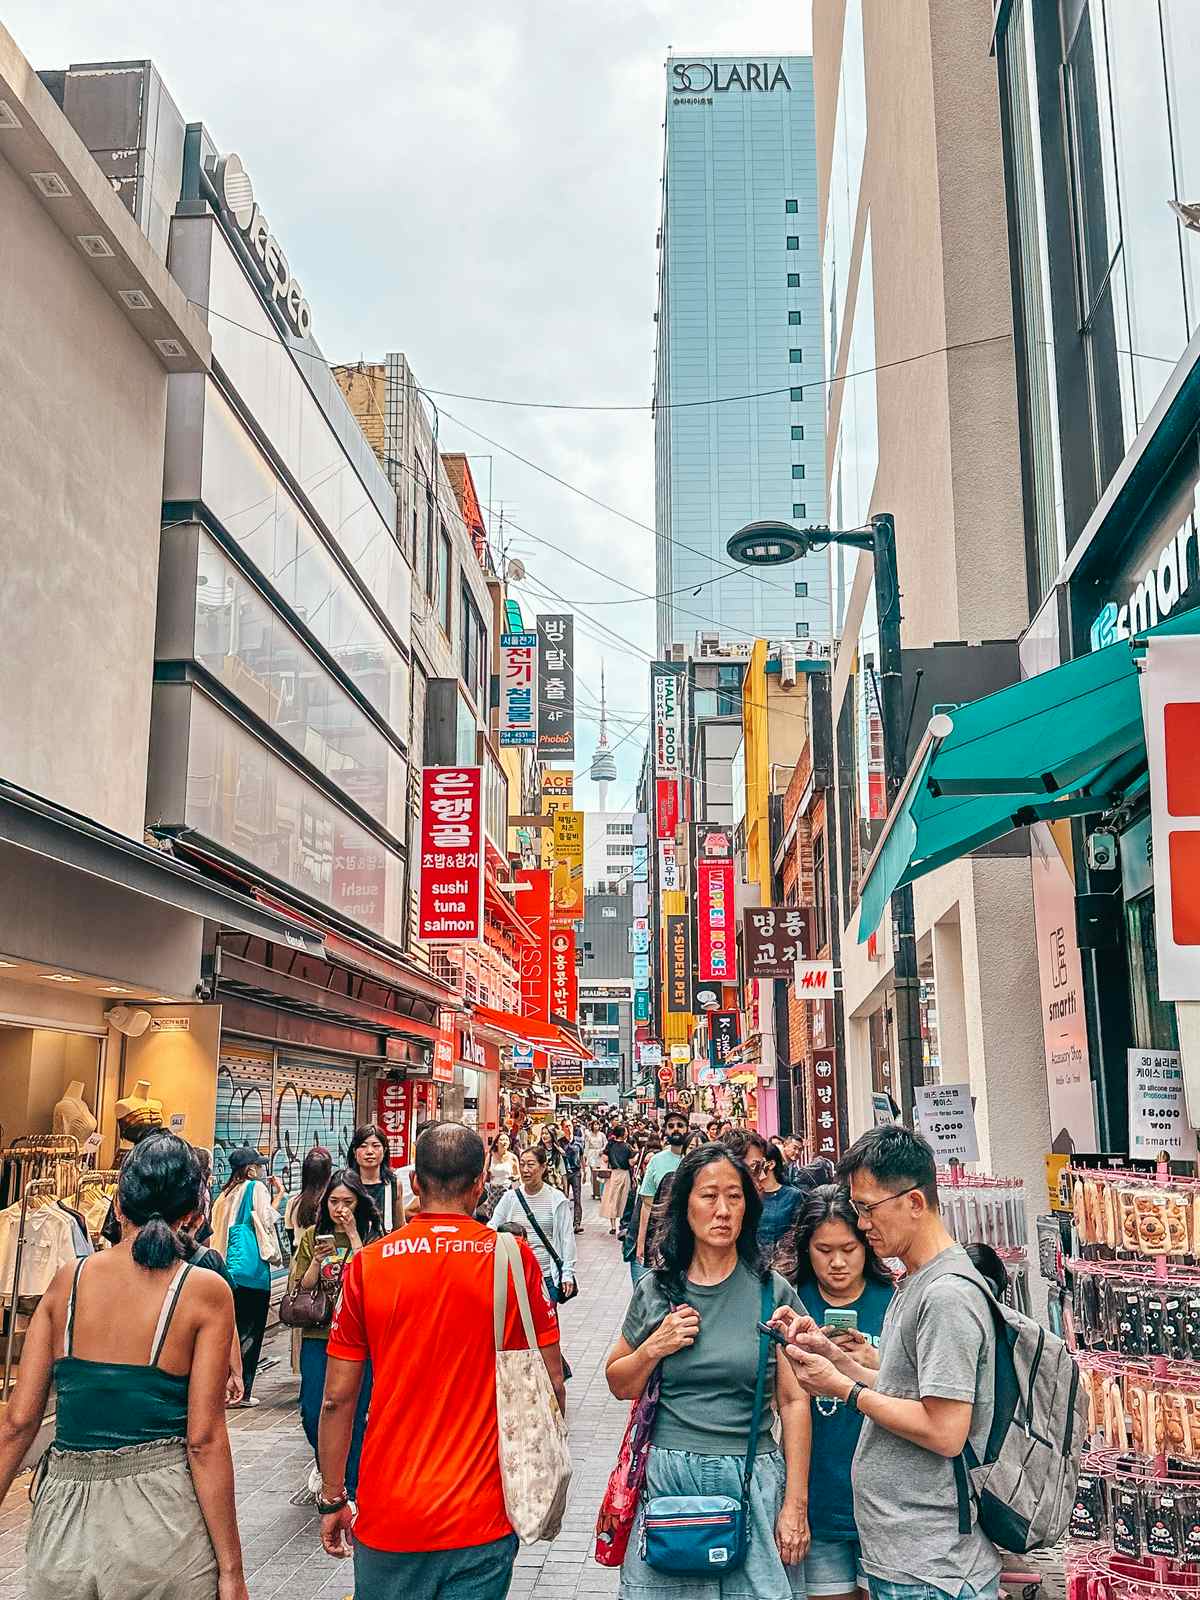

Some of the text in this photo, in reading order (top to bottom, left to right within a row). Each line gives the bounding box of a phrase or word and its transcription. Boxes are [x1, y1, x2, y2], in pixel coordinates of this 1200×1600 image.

[673, 63, 791, 92] SOLARIA
[545, 620, 566, 700] 방탈출
[665, 678, 674, 720] HALAL
[548, 711, 563, 721] 4F
[666, 727, 675, 764] FOOD
[429, 772, 474, 848] 은행골
[422, 853, 478, 869] 초밥&참치
[432, 880, 469, 895] sushi
[709, 870, 725, 928] WAPPEN
[434, 900, 466, 913] tuna
[424, 919, 475, 932] salmon
[752, 911, 806, 937] 명동
[711, 931, 727, 976] HOUSE
[754, 941, 807, 965] 교자
[674, 936, 686, 1005] SUPER PET
[801, 971, 828, 988] H&M
[1150, 1122, 1171, 1130] won
[1145, 1136, 1181, 1147] smartti
[382, 1237, 431, 1259] BBVA
